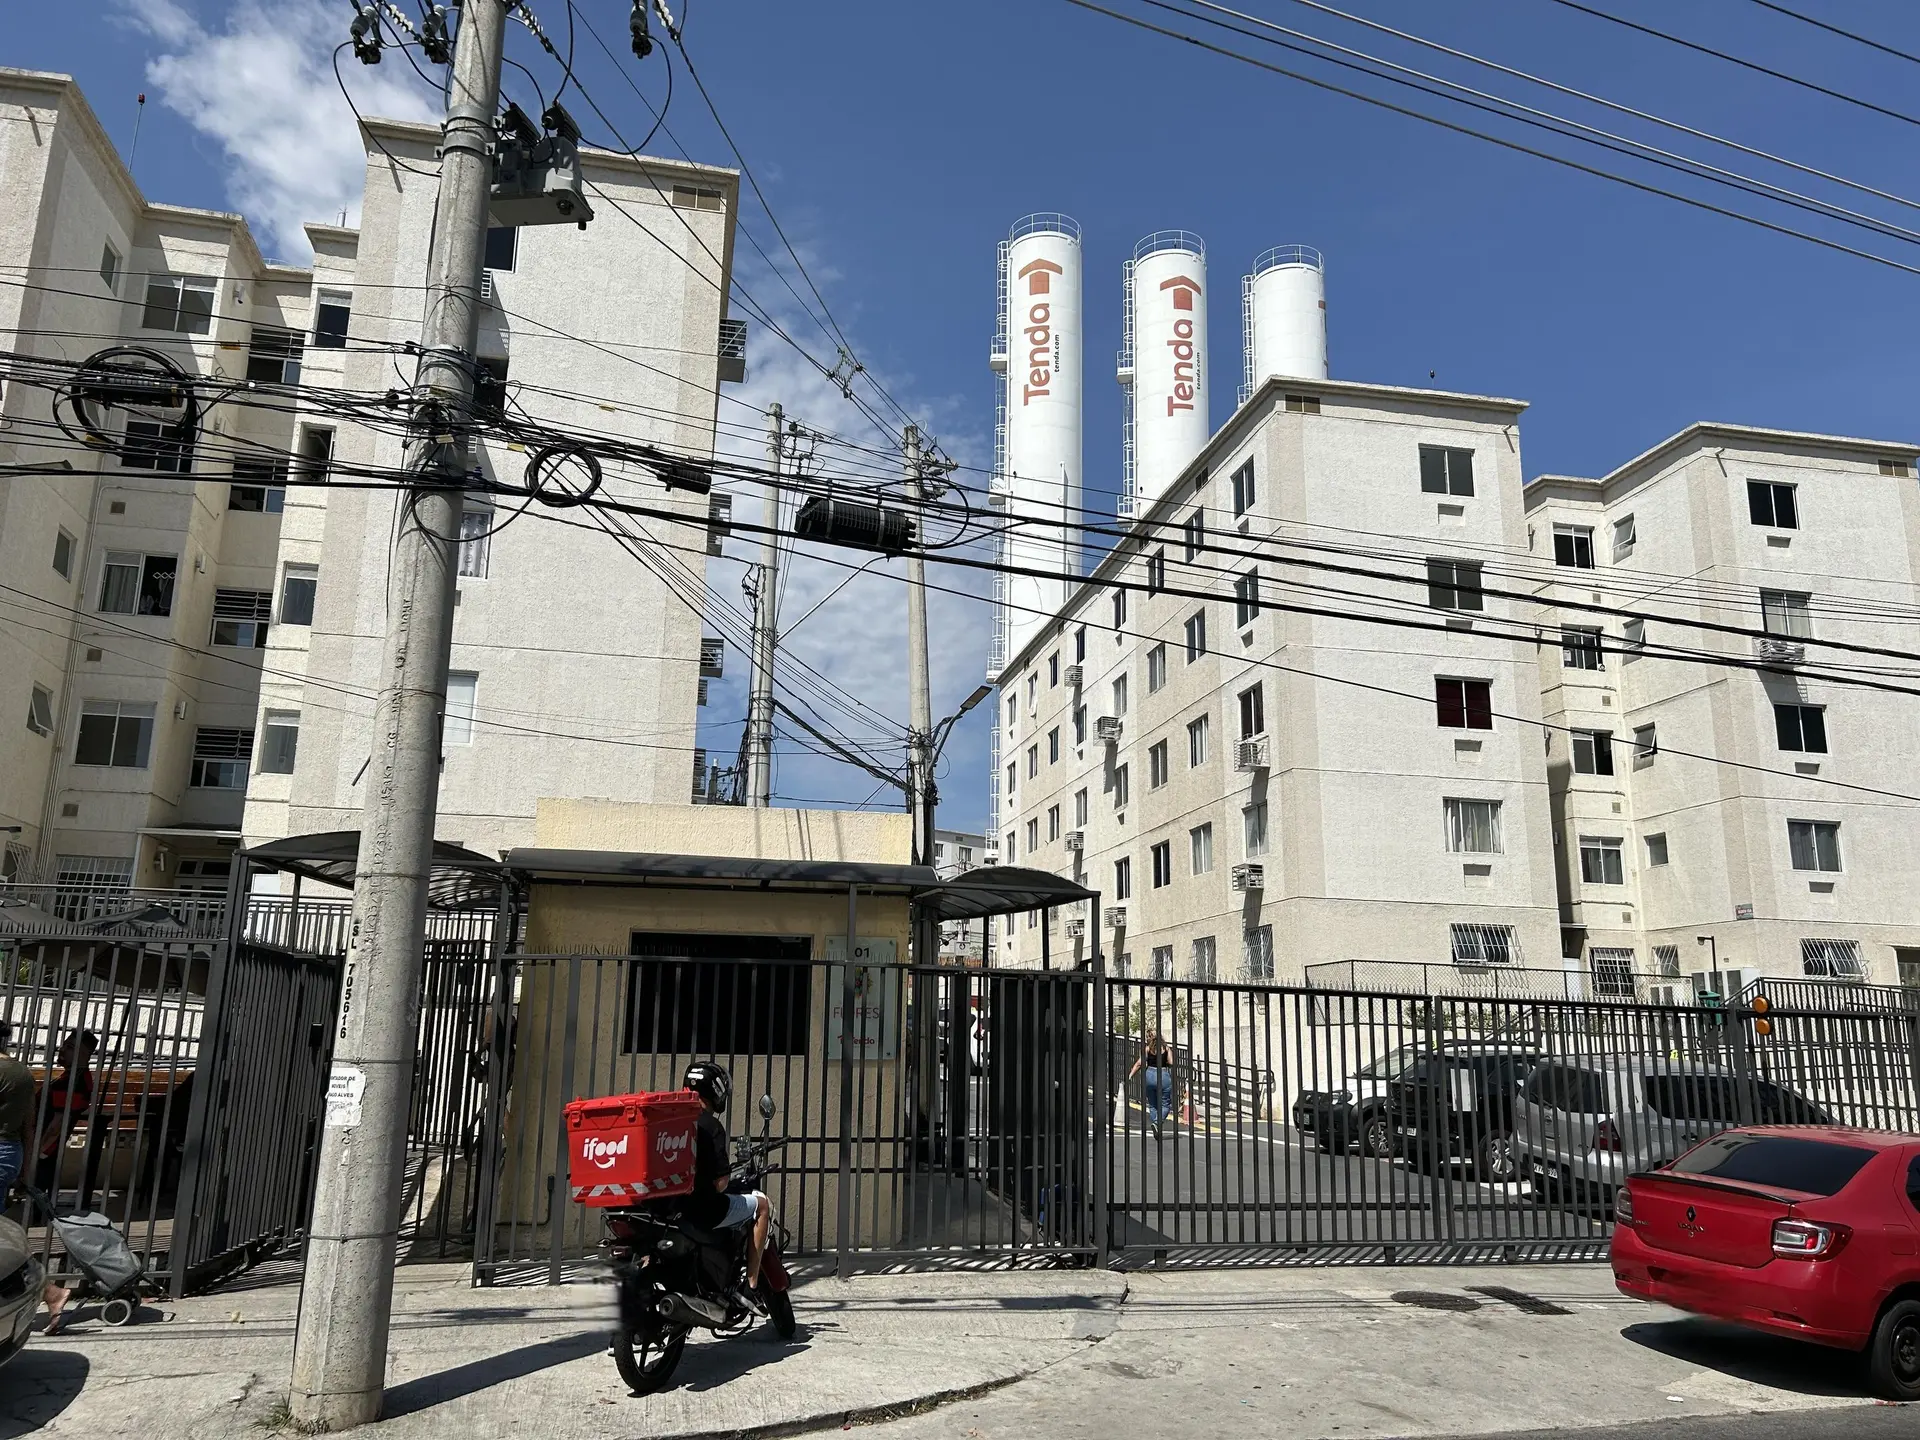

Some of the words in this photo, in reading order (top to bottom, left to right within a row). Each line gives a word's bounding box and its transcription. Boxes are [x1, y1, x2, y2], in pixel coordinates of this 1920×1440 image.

[1024, 303, 1050, 406] Tenda
[1167, 319, 1194, 417] Tenda
[854, 947, 870, 958] 01
[340, 963, 355, 1039] 705616
[583, 1135, 629, 1160] ifood
[656, 1130, 689, 1154] ifood
